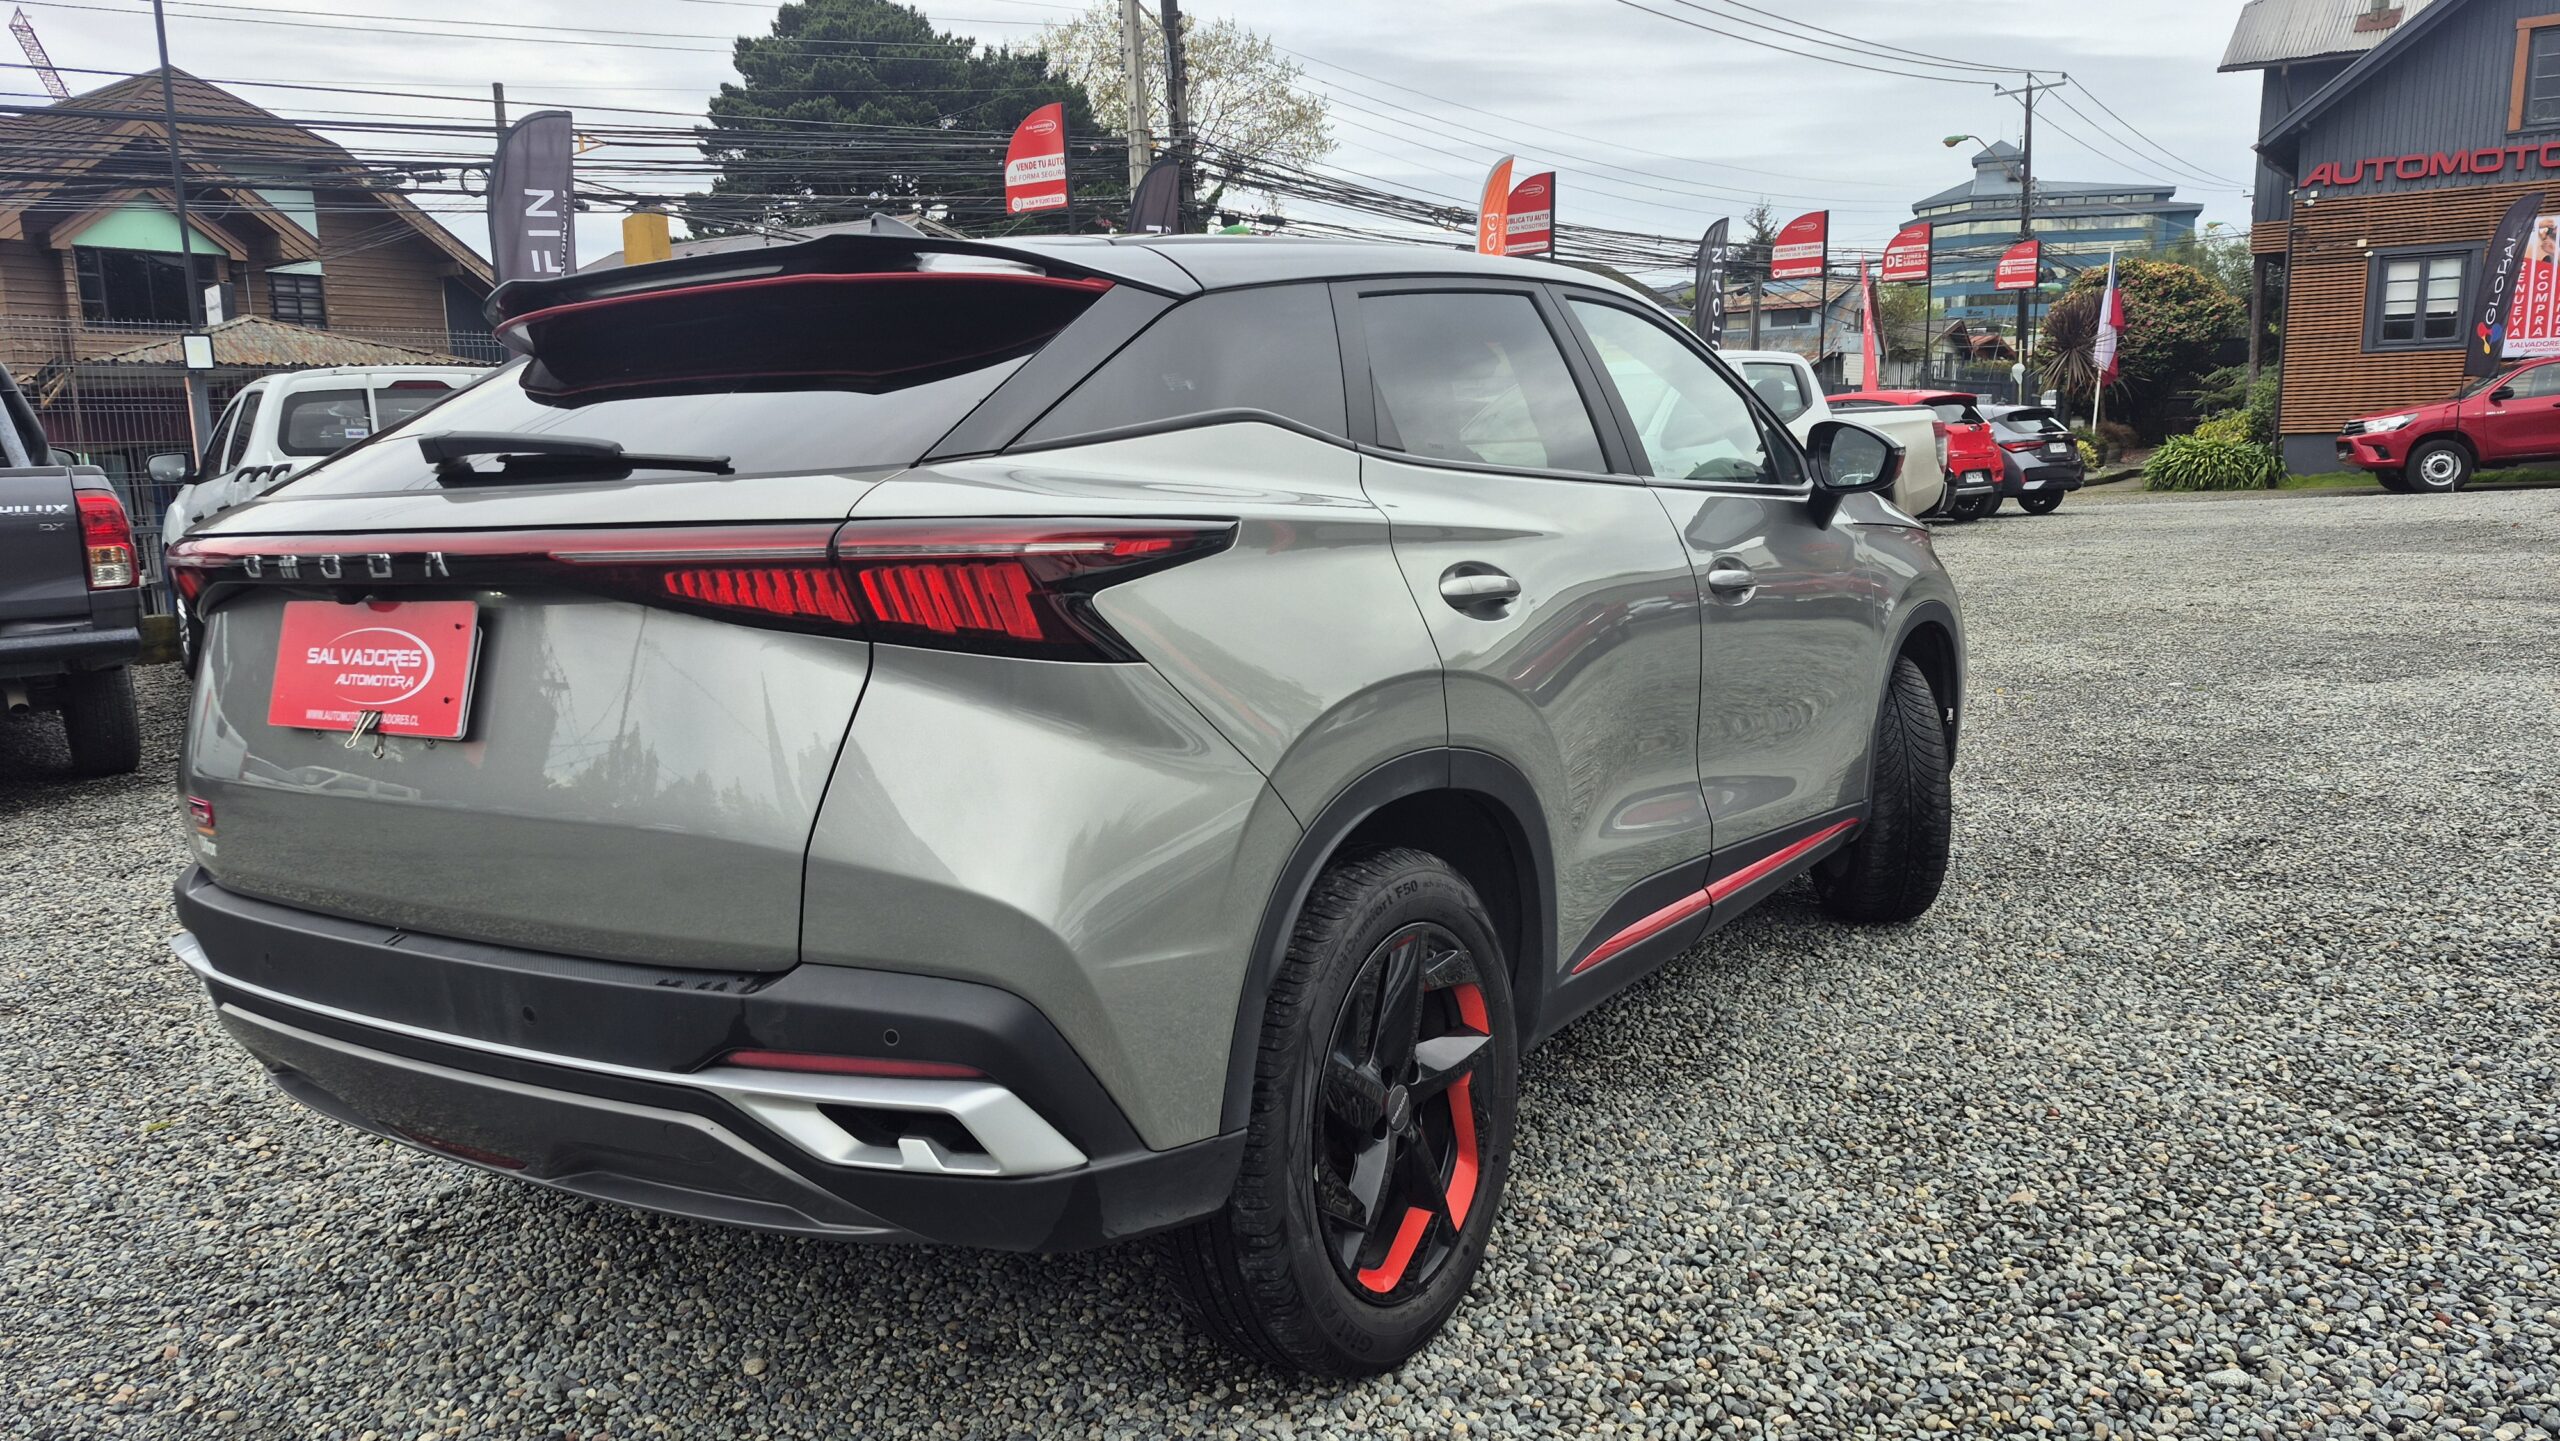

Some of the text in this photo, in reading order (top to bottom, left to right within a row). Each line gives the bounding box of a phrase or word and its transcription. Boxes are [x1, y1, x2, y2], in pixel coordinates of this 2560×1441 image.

[1016, 156, 1065, 172] VENDE TU AUTO
[2301, 141, 2560, 188] AUTOMOTO
[1018, 172, 1040, 182] FORMA
[1041, 169, 1066, 179] SEGURA
[1506, 215, 1526, 225] UBLICA
[1534, 213, 1549, 221] AUTO
[1521, 222, 1549, 231] NOSOTROS
[1886, 255, 1903, 268] DE
[1999, 266, 2012, 276] EN
[1711, 247, 1723, 350] UTOFIN
[2532, 269, 2549, 338] COMPRA
[244, 551, 450, 579] OMODA
[306, 647, 422, 674] SALVADORES
[334, 673, 415, 690] AUTOMOTORA
[1394, 880, 1419, 899] F50
